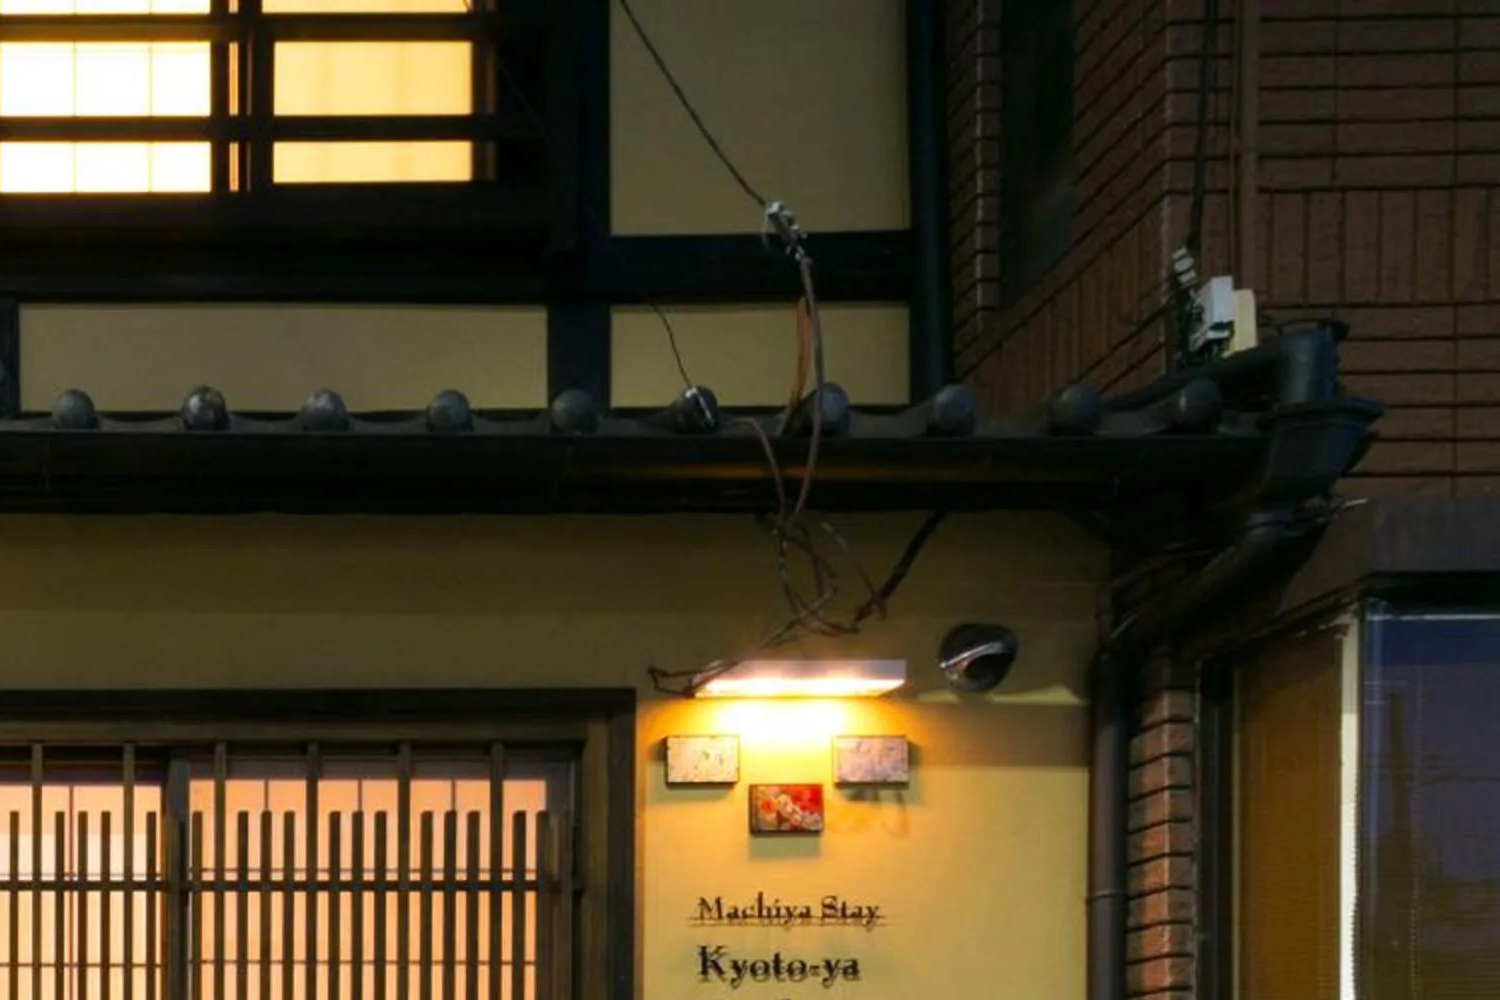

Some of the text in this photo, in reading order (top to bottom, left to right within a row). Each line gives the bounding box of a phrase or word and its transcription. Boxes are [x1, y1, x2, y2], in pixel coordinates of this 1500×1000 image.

[697, 890, 881, 932] Machiya Stay
[698, 944, 862, 988] Kyoto-ya
